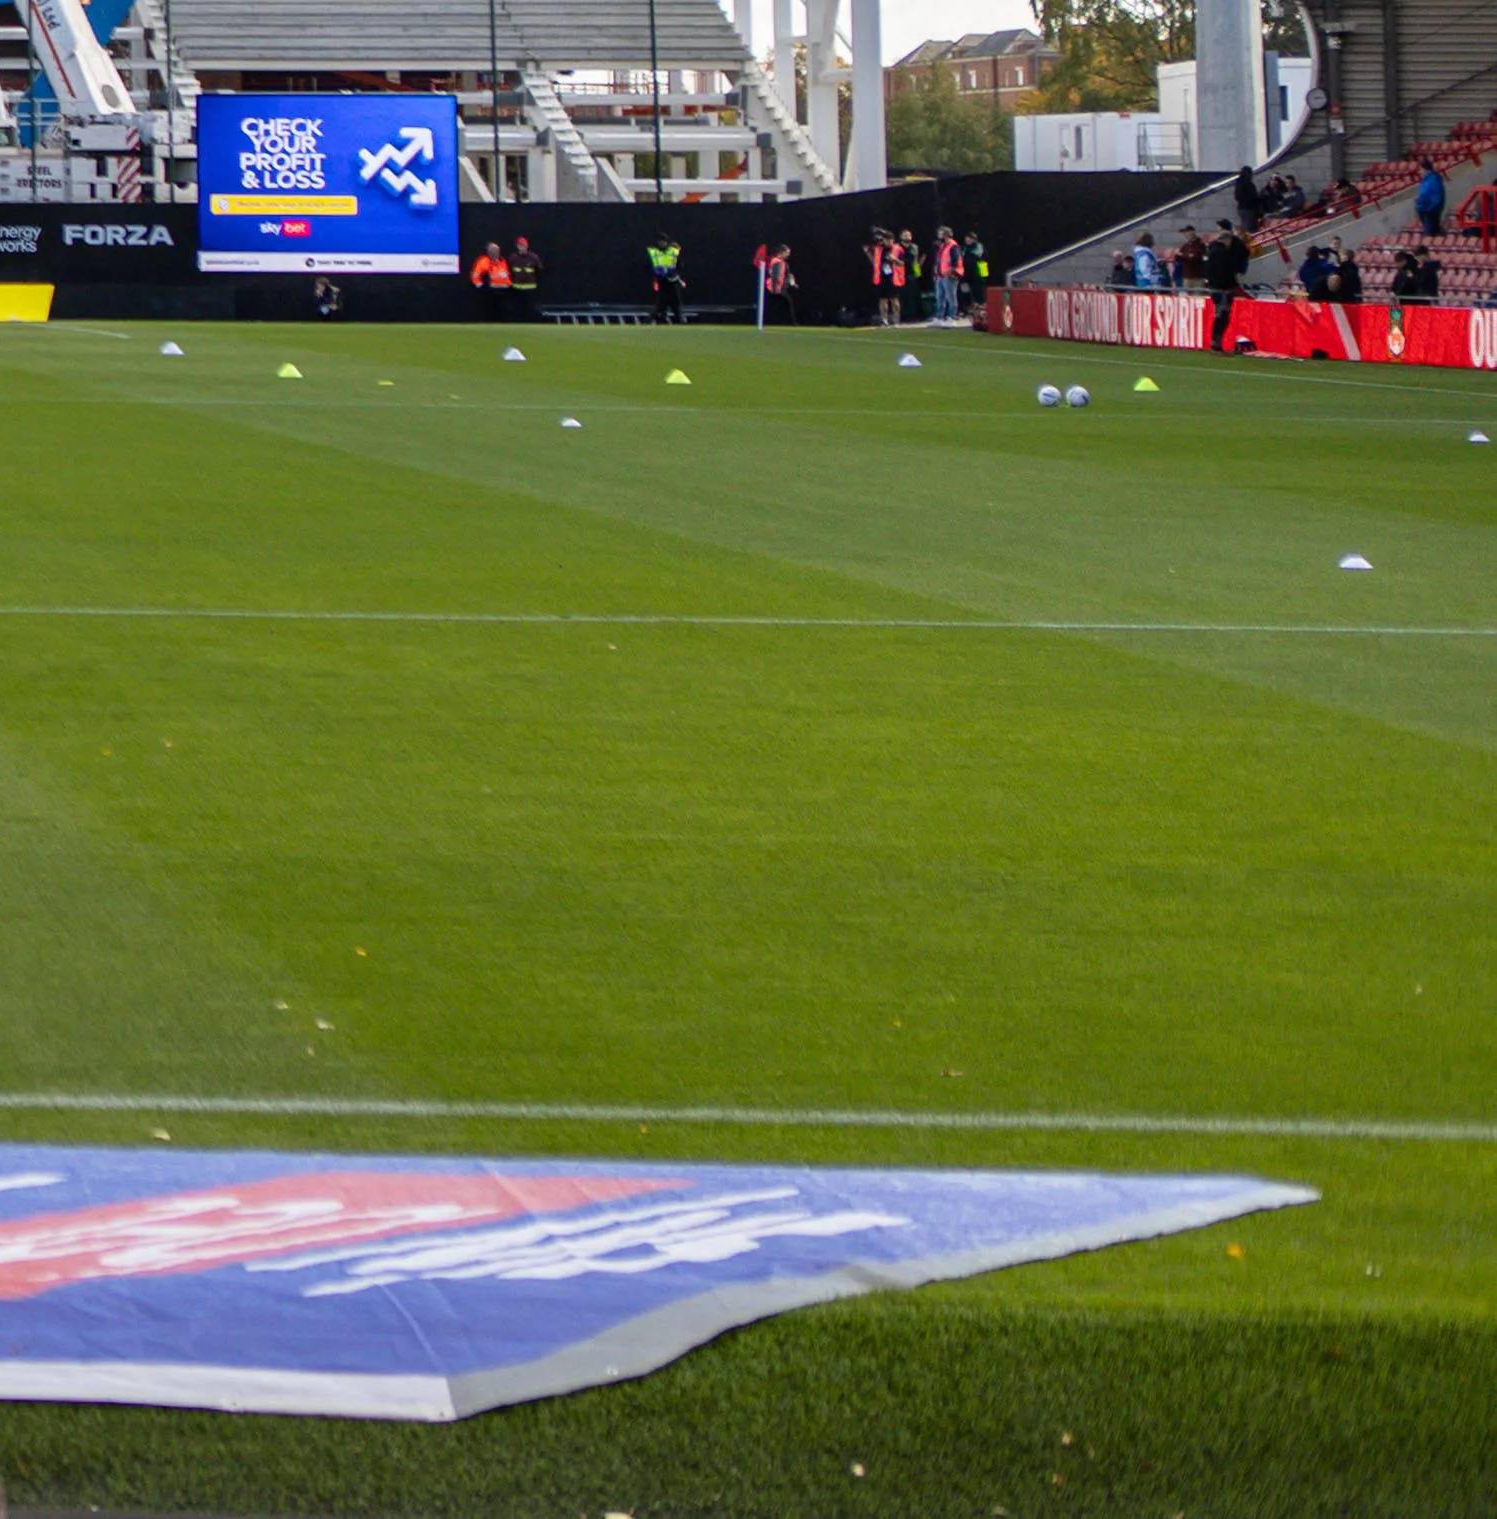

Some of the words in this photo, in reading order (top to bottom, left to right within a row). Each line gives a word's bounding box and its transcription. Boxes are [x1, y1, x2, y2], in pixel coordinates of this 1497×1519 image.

[240, 117, 324, 138] CHECK
[252, 135, 317, 154] YOUR
[240, 152, 326, 171] PROFIT
[241, 170, 261, 190] &
[264, 170, 326, 190] LOSS
[63, 224, 175, 246] FORZA
[259, 221, 282, 236] sky
[1046, 290, 1071, 338] OUR
[1073, 292, 1122, 344] GROUND,
[1124, 294, 1153, 346] OUR
[1154, 295, 1206, 349] SPIRIT
